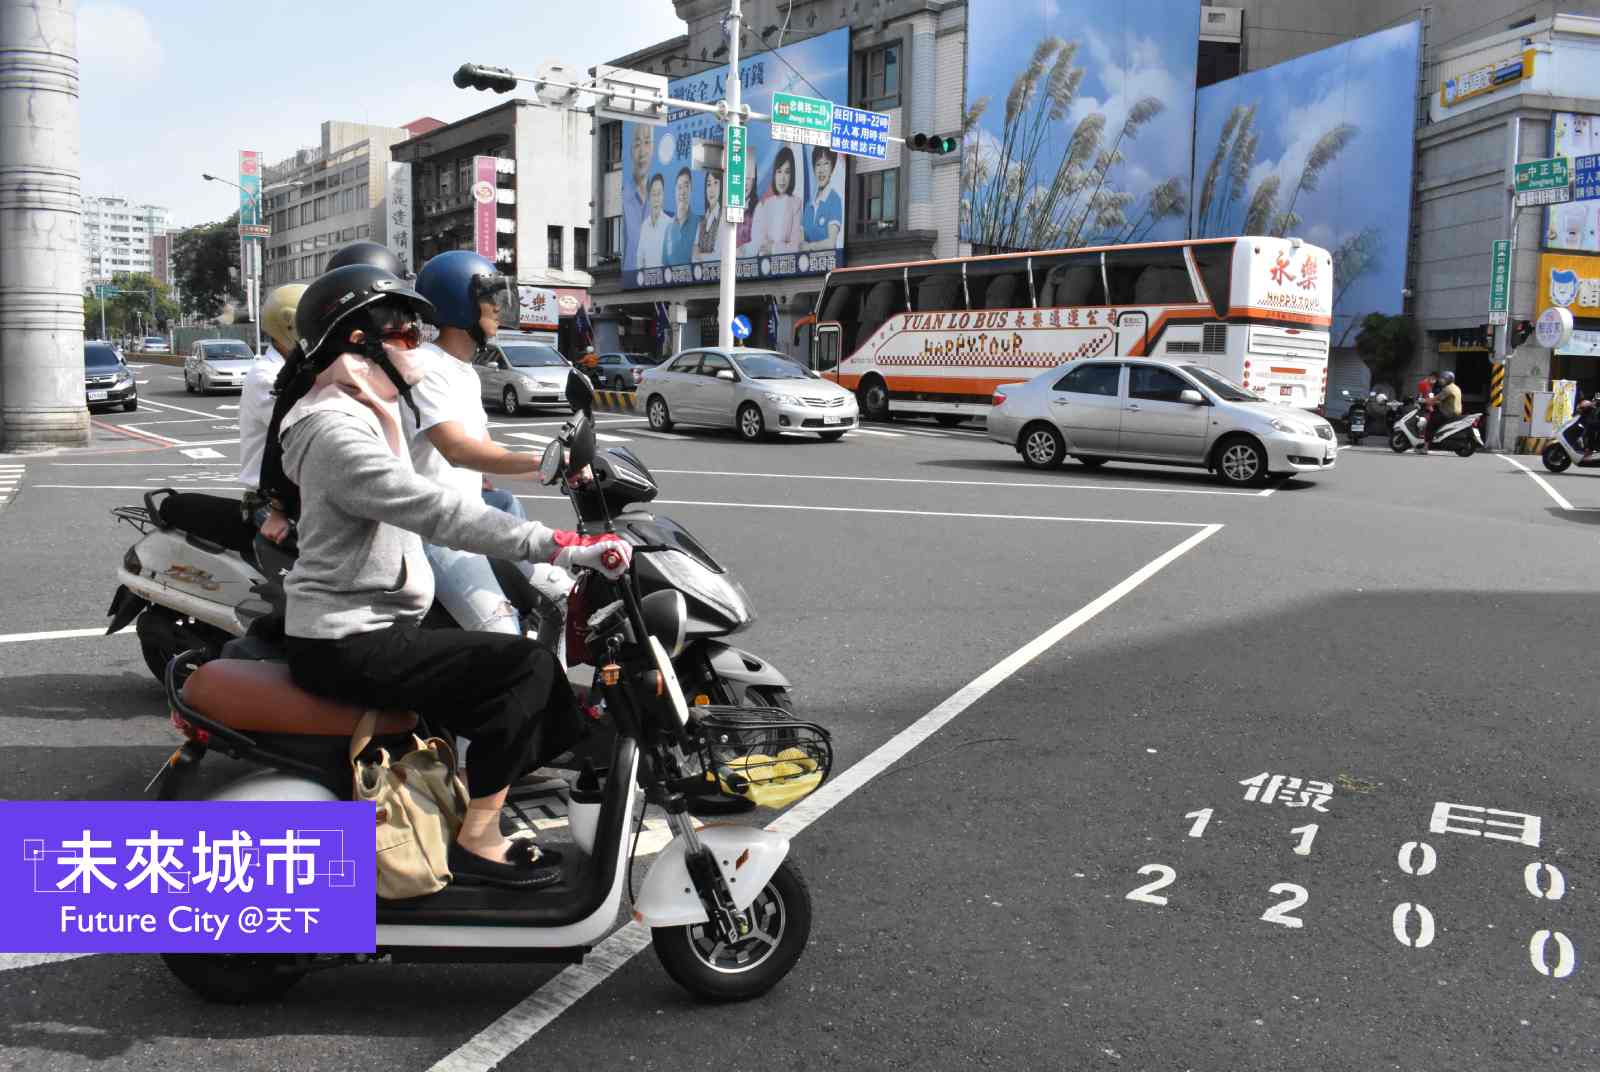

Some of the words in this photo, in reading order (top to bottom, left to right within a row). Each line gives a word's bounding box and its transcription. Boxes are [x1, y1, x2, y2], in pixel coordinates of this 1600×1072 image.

[1575, 171, 1600, 185] 行人
[1269, 249, 1318, 290] 永樂
[901, 313, 946, 330] YUAN
[947, 312, 974, 329] LO
[974, 312, 1009, 329] BUS
